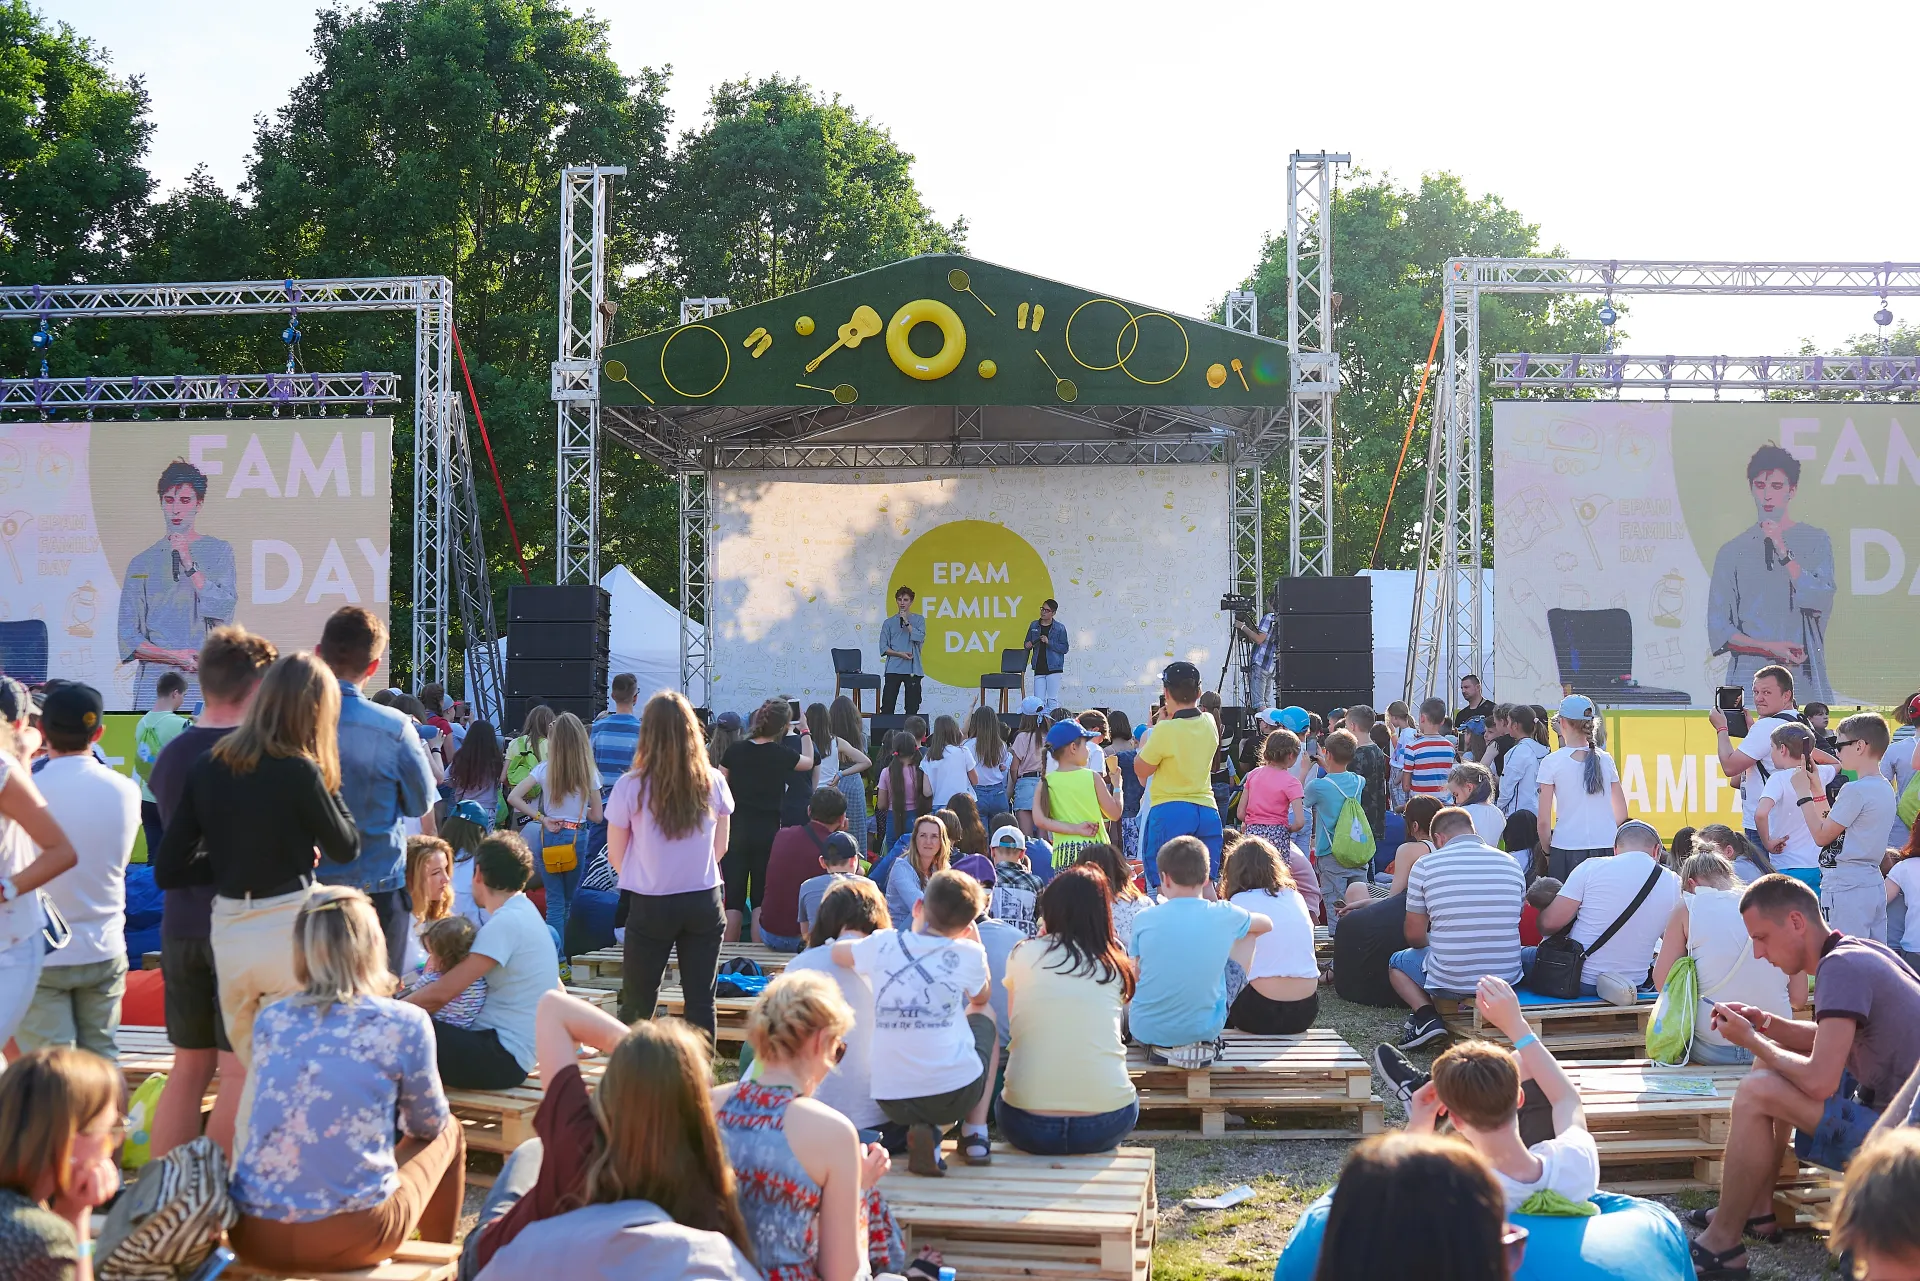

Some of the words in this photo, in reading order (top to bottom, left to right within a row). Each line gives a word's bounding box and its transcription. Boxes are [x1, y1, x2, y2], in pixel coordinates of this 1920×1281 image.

[1619, 499, 1672, 516] EPAM
[38, 514, 87, 531] EPAM
[1619, 521, 1685, 539] FAMILY
[38, 536, 100, 553] FAMILY
[1619, 546, 1656, 562] DAY
[1850, 528, 1920, 596] D
[38, 559, 71, 575] DAY
[251, 538, 390, 604] DAY
[933, 562, 1010, 584] EPAM
[922, 596, 1023, 618] FAMILY
[945, 631, 1000, 652] DAY
